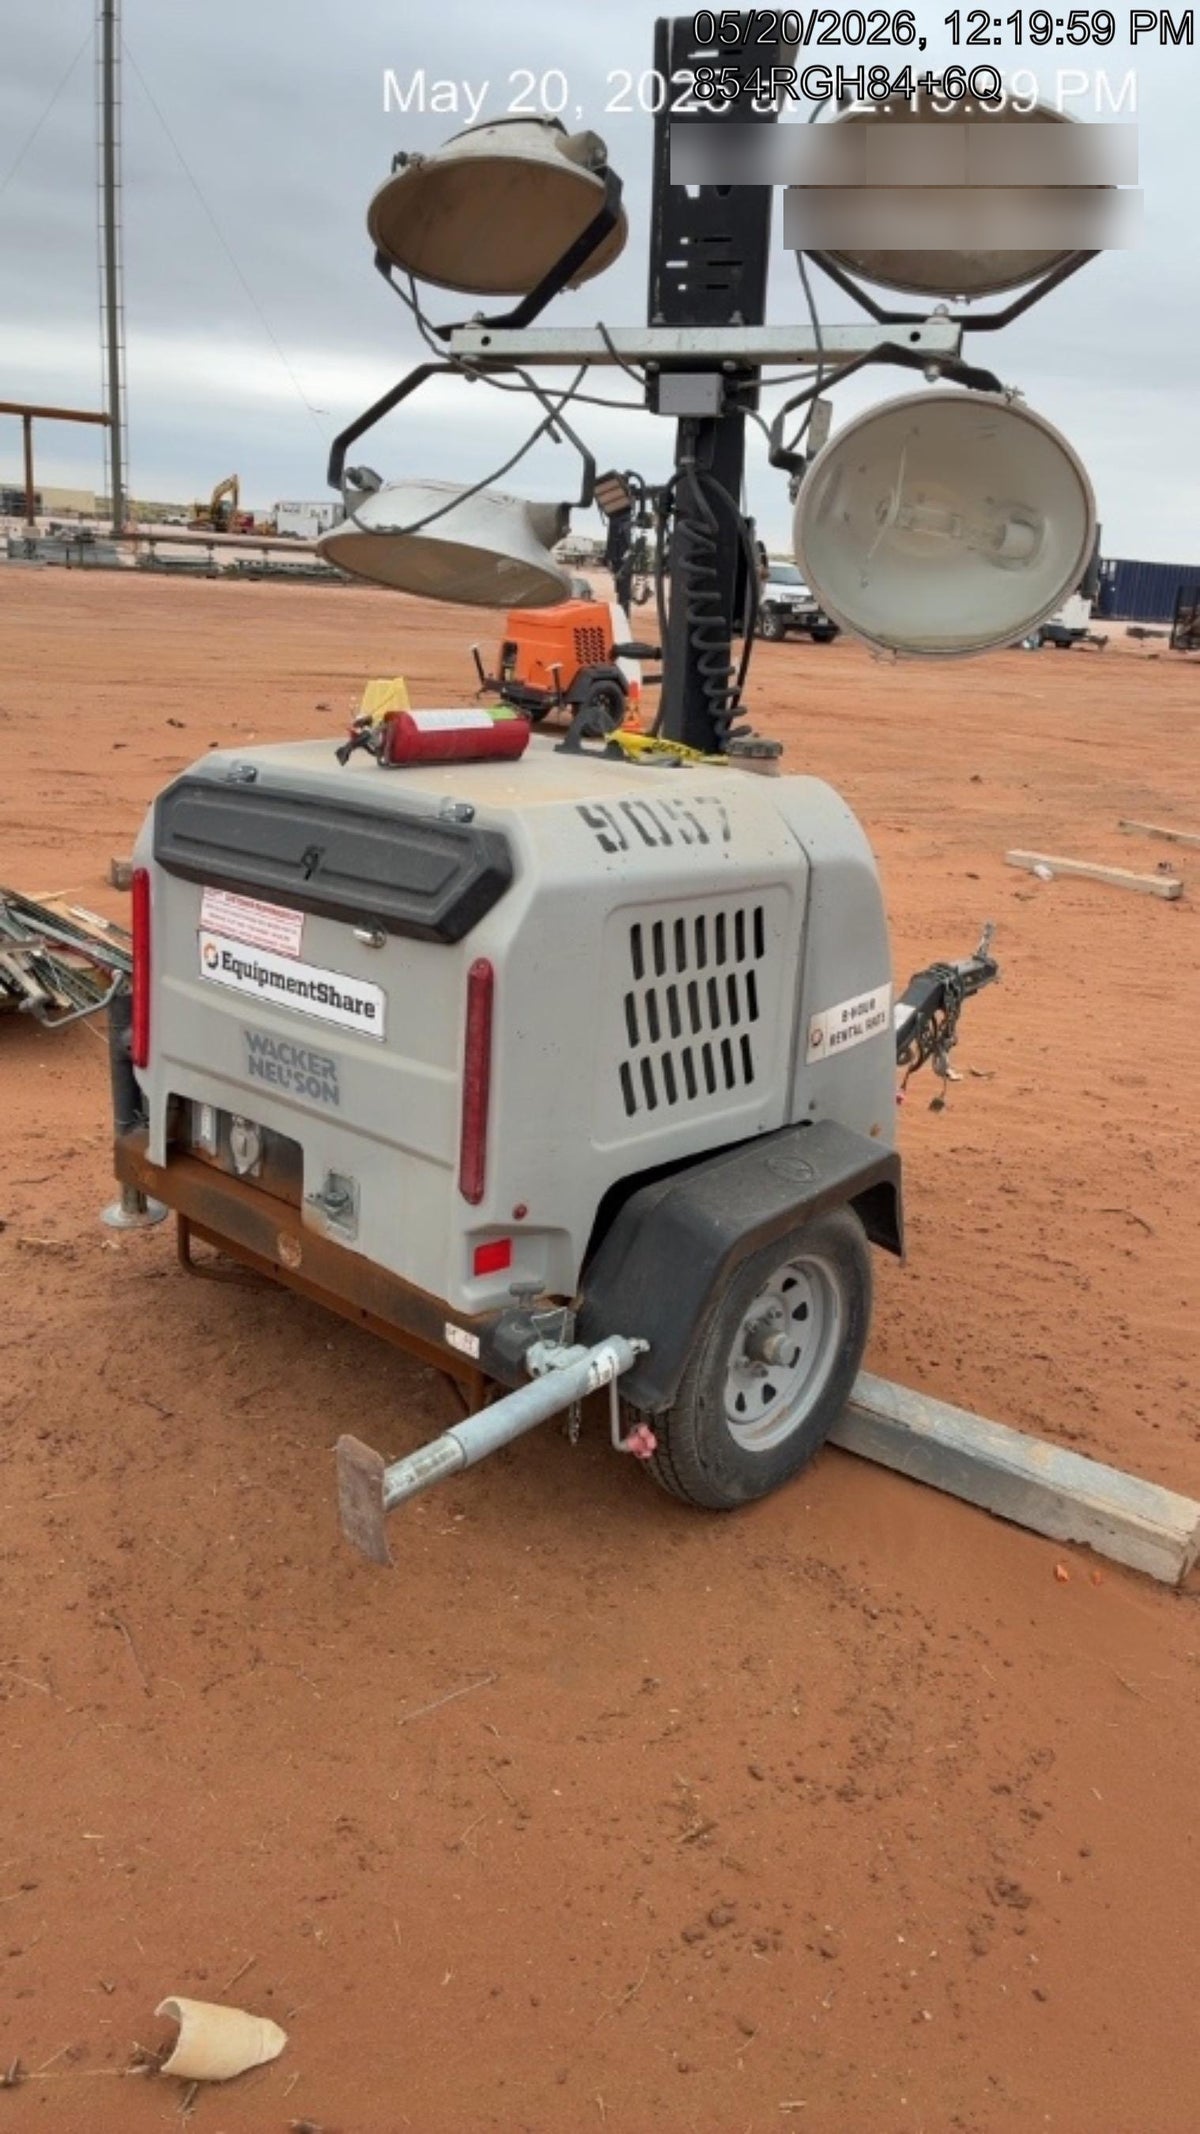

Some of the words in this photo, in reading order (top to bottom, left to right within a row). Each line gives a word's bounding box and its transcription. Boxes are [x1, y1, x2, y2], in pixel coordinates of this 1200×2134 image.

[574, 796, 732, 853] 9057
[221, 950, 377, 1019] EquipmentShare
[245, 1030, 338, 1082] WACKER
[248, 1053, 340, 1106] NEUSON
